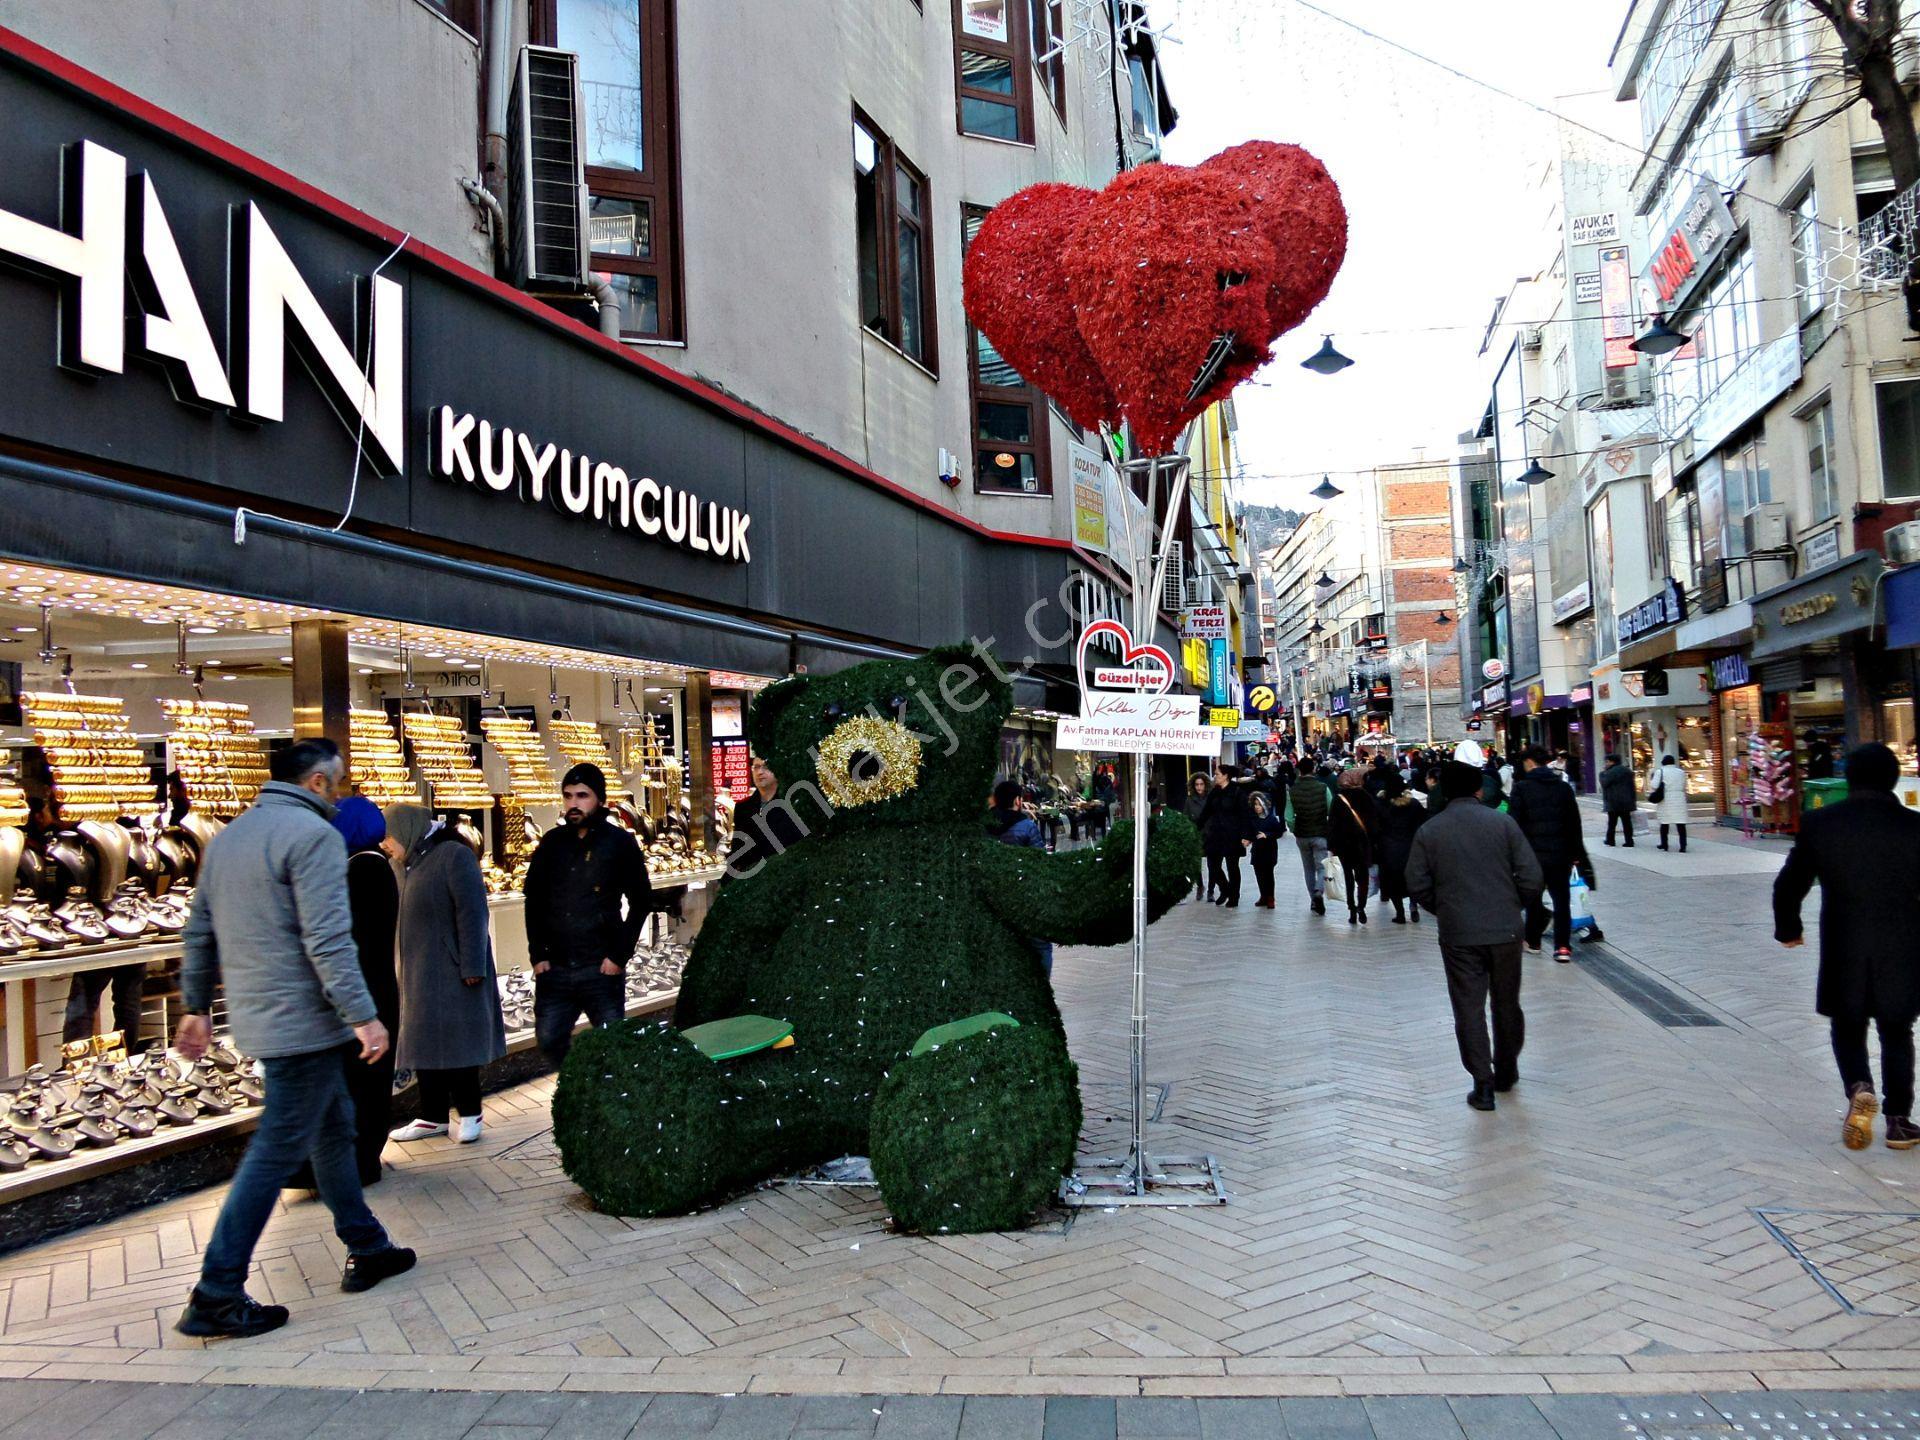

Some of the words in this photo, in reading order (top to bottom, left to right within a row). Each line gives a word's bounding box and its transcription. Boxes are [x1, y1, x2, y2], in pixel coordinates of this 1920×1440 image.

[1573, 213, 1614, 230] AVUKAT
[440, 404, 750, 564] KUYUMCULUK
[1193, 608, 1224, 616] KRAL
[1192, 618, 1225, 627] TERZİ
[1098, 672, 1132, 684] Güzel
[1135, 673, 1164, 688] İşler
[1093, 697, 1138, 717] Kalbe
[1148, 698, 1195, 720] Değer
[1211, 711, 1236, 721] EYFEL
[1112, 726, 1157, 738] KAPLAN
[1159, 728, 1216, 740] HÜRRİYET
[1082, 737, 1106, 746] İZMİT
[1107, 738, 1152, 749] BELEDİYE
[1155, 739, 1195, 750] BAŞKANI
